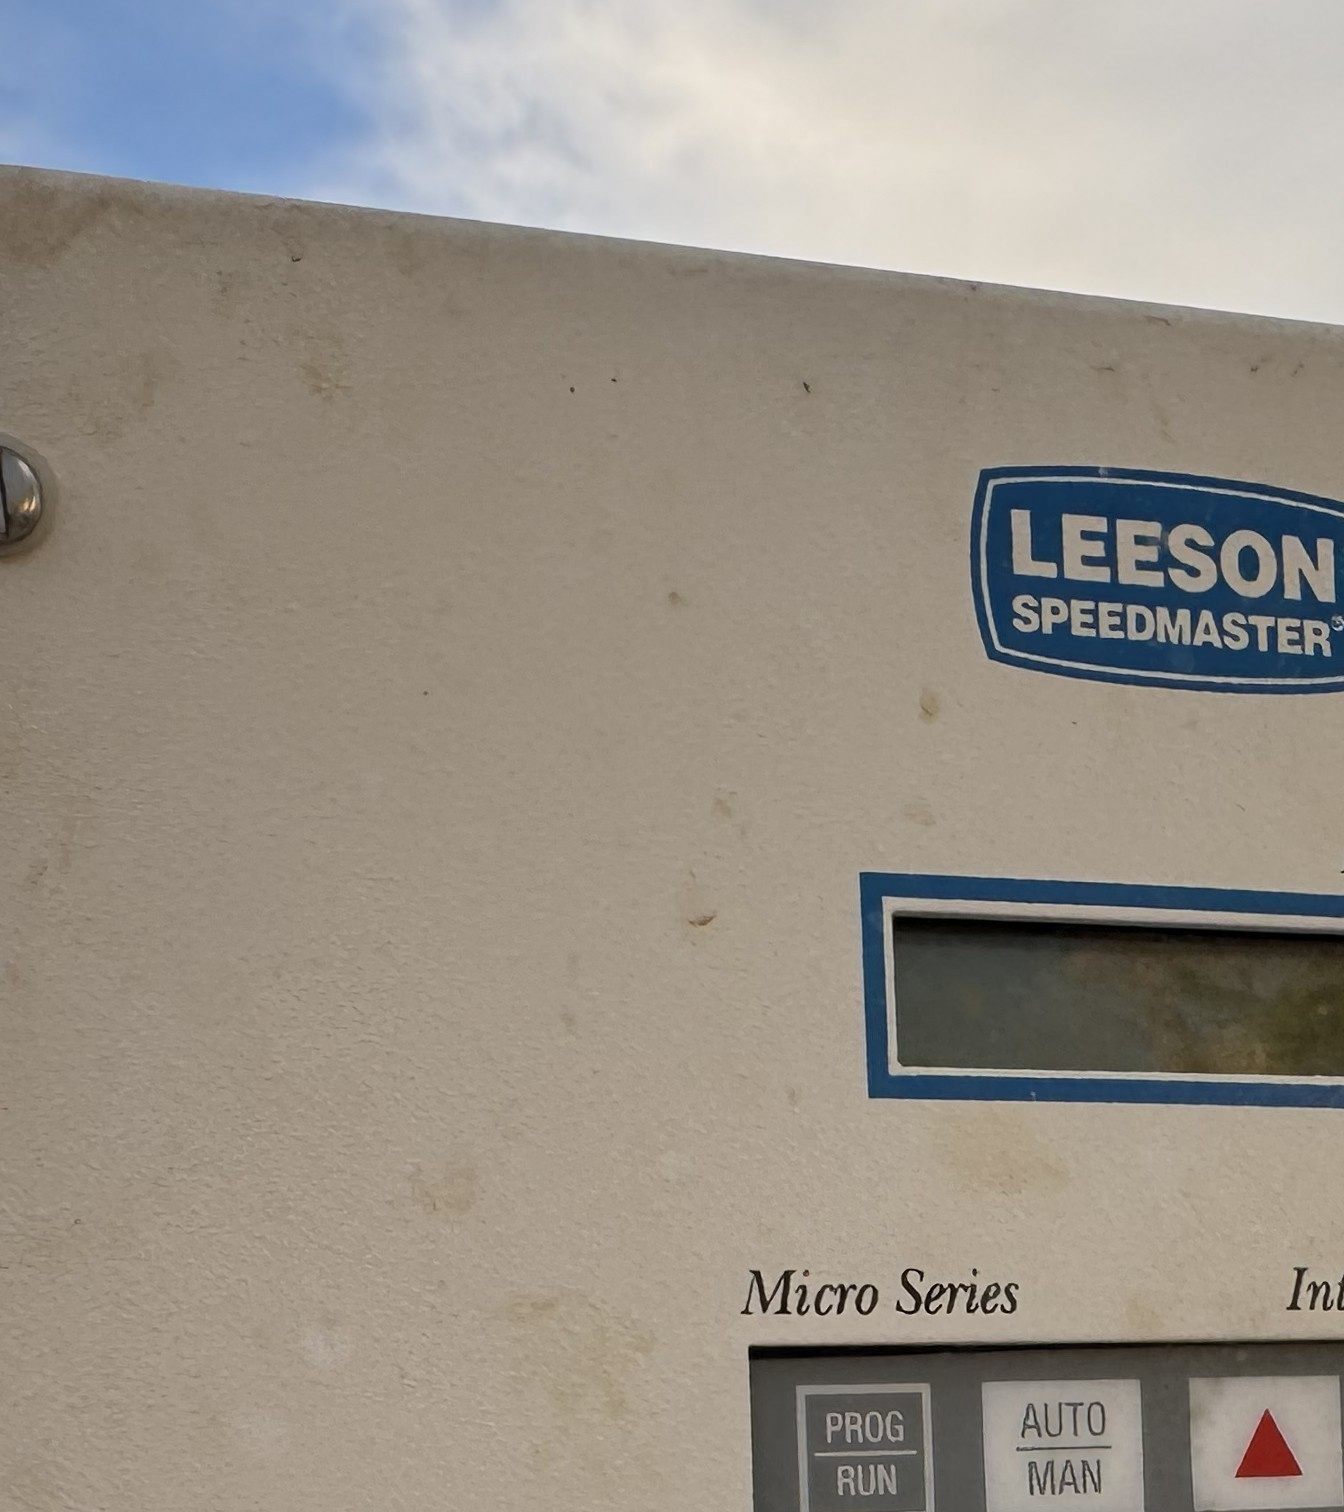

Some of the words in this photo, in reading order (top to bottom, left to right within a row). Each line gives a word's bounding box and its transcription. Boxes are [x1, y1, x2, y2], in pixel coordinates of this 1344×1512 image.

[1011, 509, 1336, 603] LEESON
[740, 1267, 879, 1317] Micro
[895, 1267, 1020, 1317] Series
[824, 1410, 905, 1445] PROG
[1020, 1401, 1107, 1439] AUTO
[836, 1463, 898, 1497] RUN
[1027, 1458, 1103, 1497] MAN
